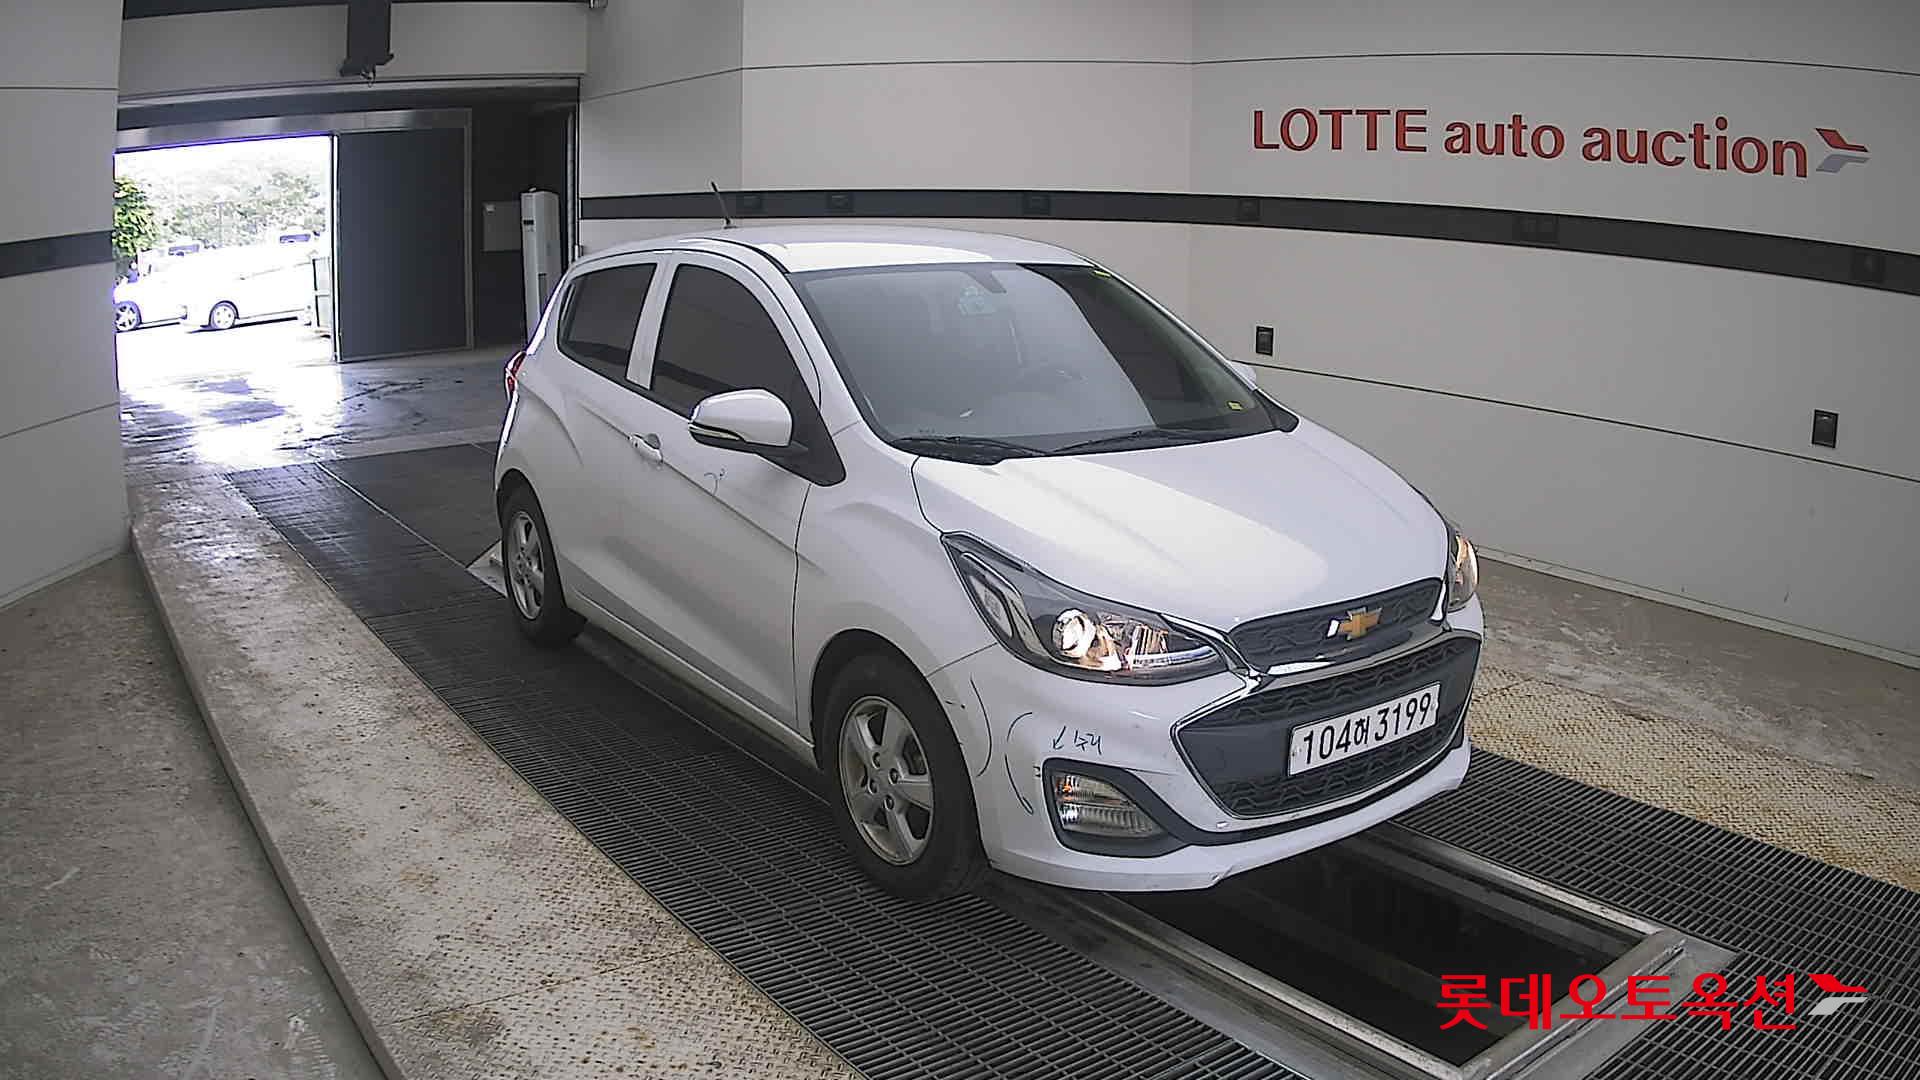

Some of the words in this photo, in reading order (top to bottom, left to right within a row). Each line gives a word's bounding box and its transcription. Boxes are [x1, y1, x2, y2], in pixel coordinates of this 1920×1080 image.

[1253, 108, 1428, 152] LOTTE
[1444, 114, 1564, 159] auto
[1582, 116, 1808, 178] auction
